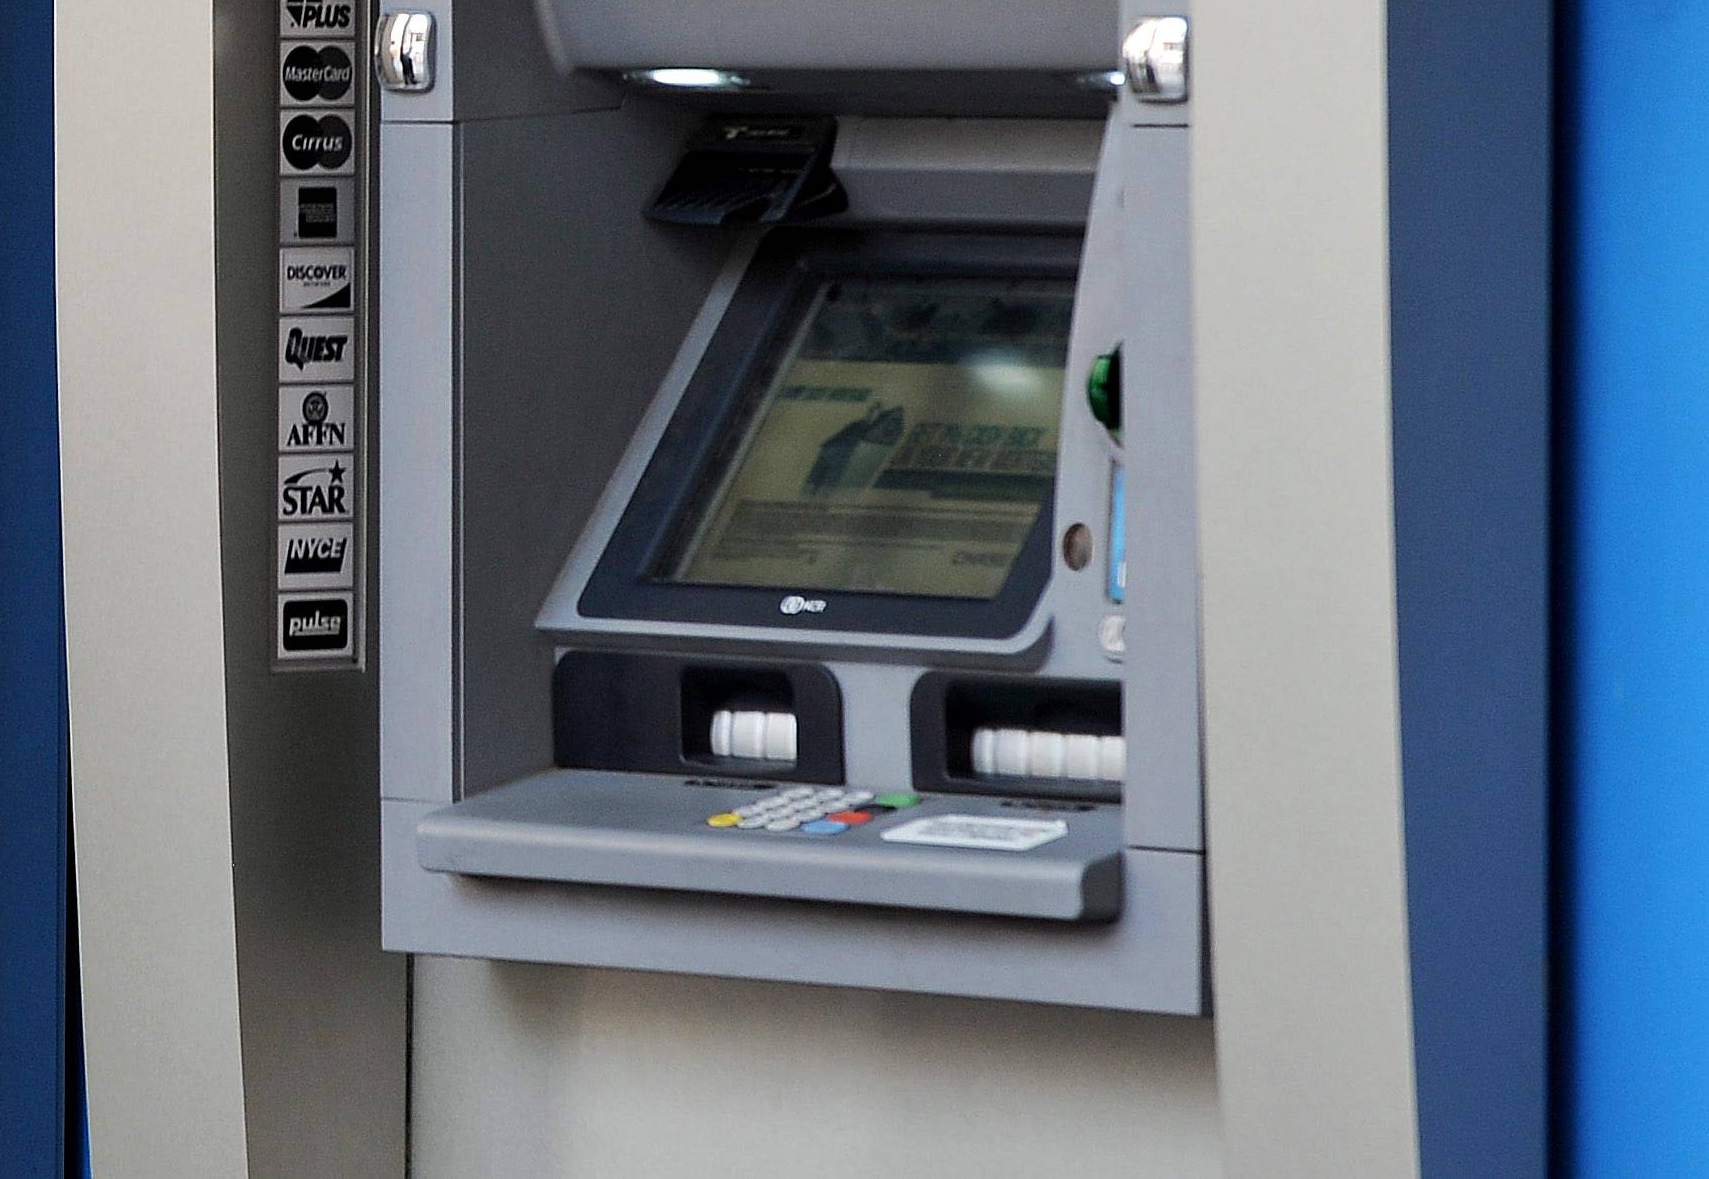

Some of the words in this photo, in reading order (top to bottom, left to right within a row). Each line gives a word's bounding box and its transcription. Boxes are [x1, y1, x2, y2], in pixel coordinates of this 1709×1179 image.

[302, 4, 351, 29] PLUS
[285, 65, 351, 83] MasterCard
[292, 133, 344, 152] Cirrus
[286, 265, 347, 281] DISCOVER
[287, 422, 346, 446] AFFN
[282, 485, 347, 516] STAR
[291, 537, 343, 560] NYCE
[289, 609, 342, 637] pulse
